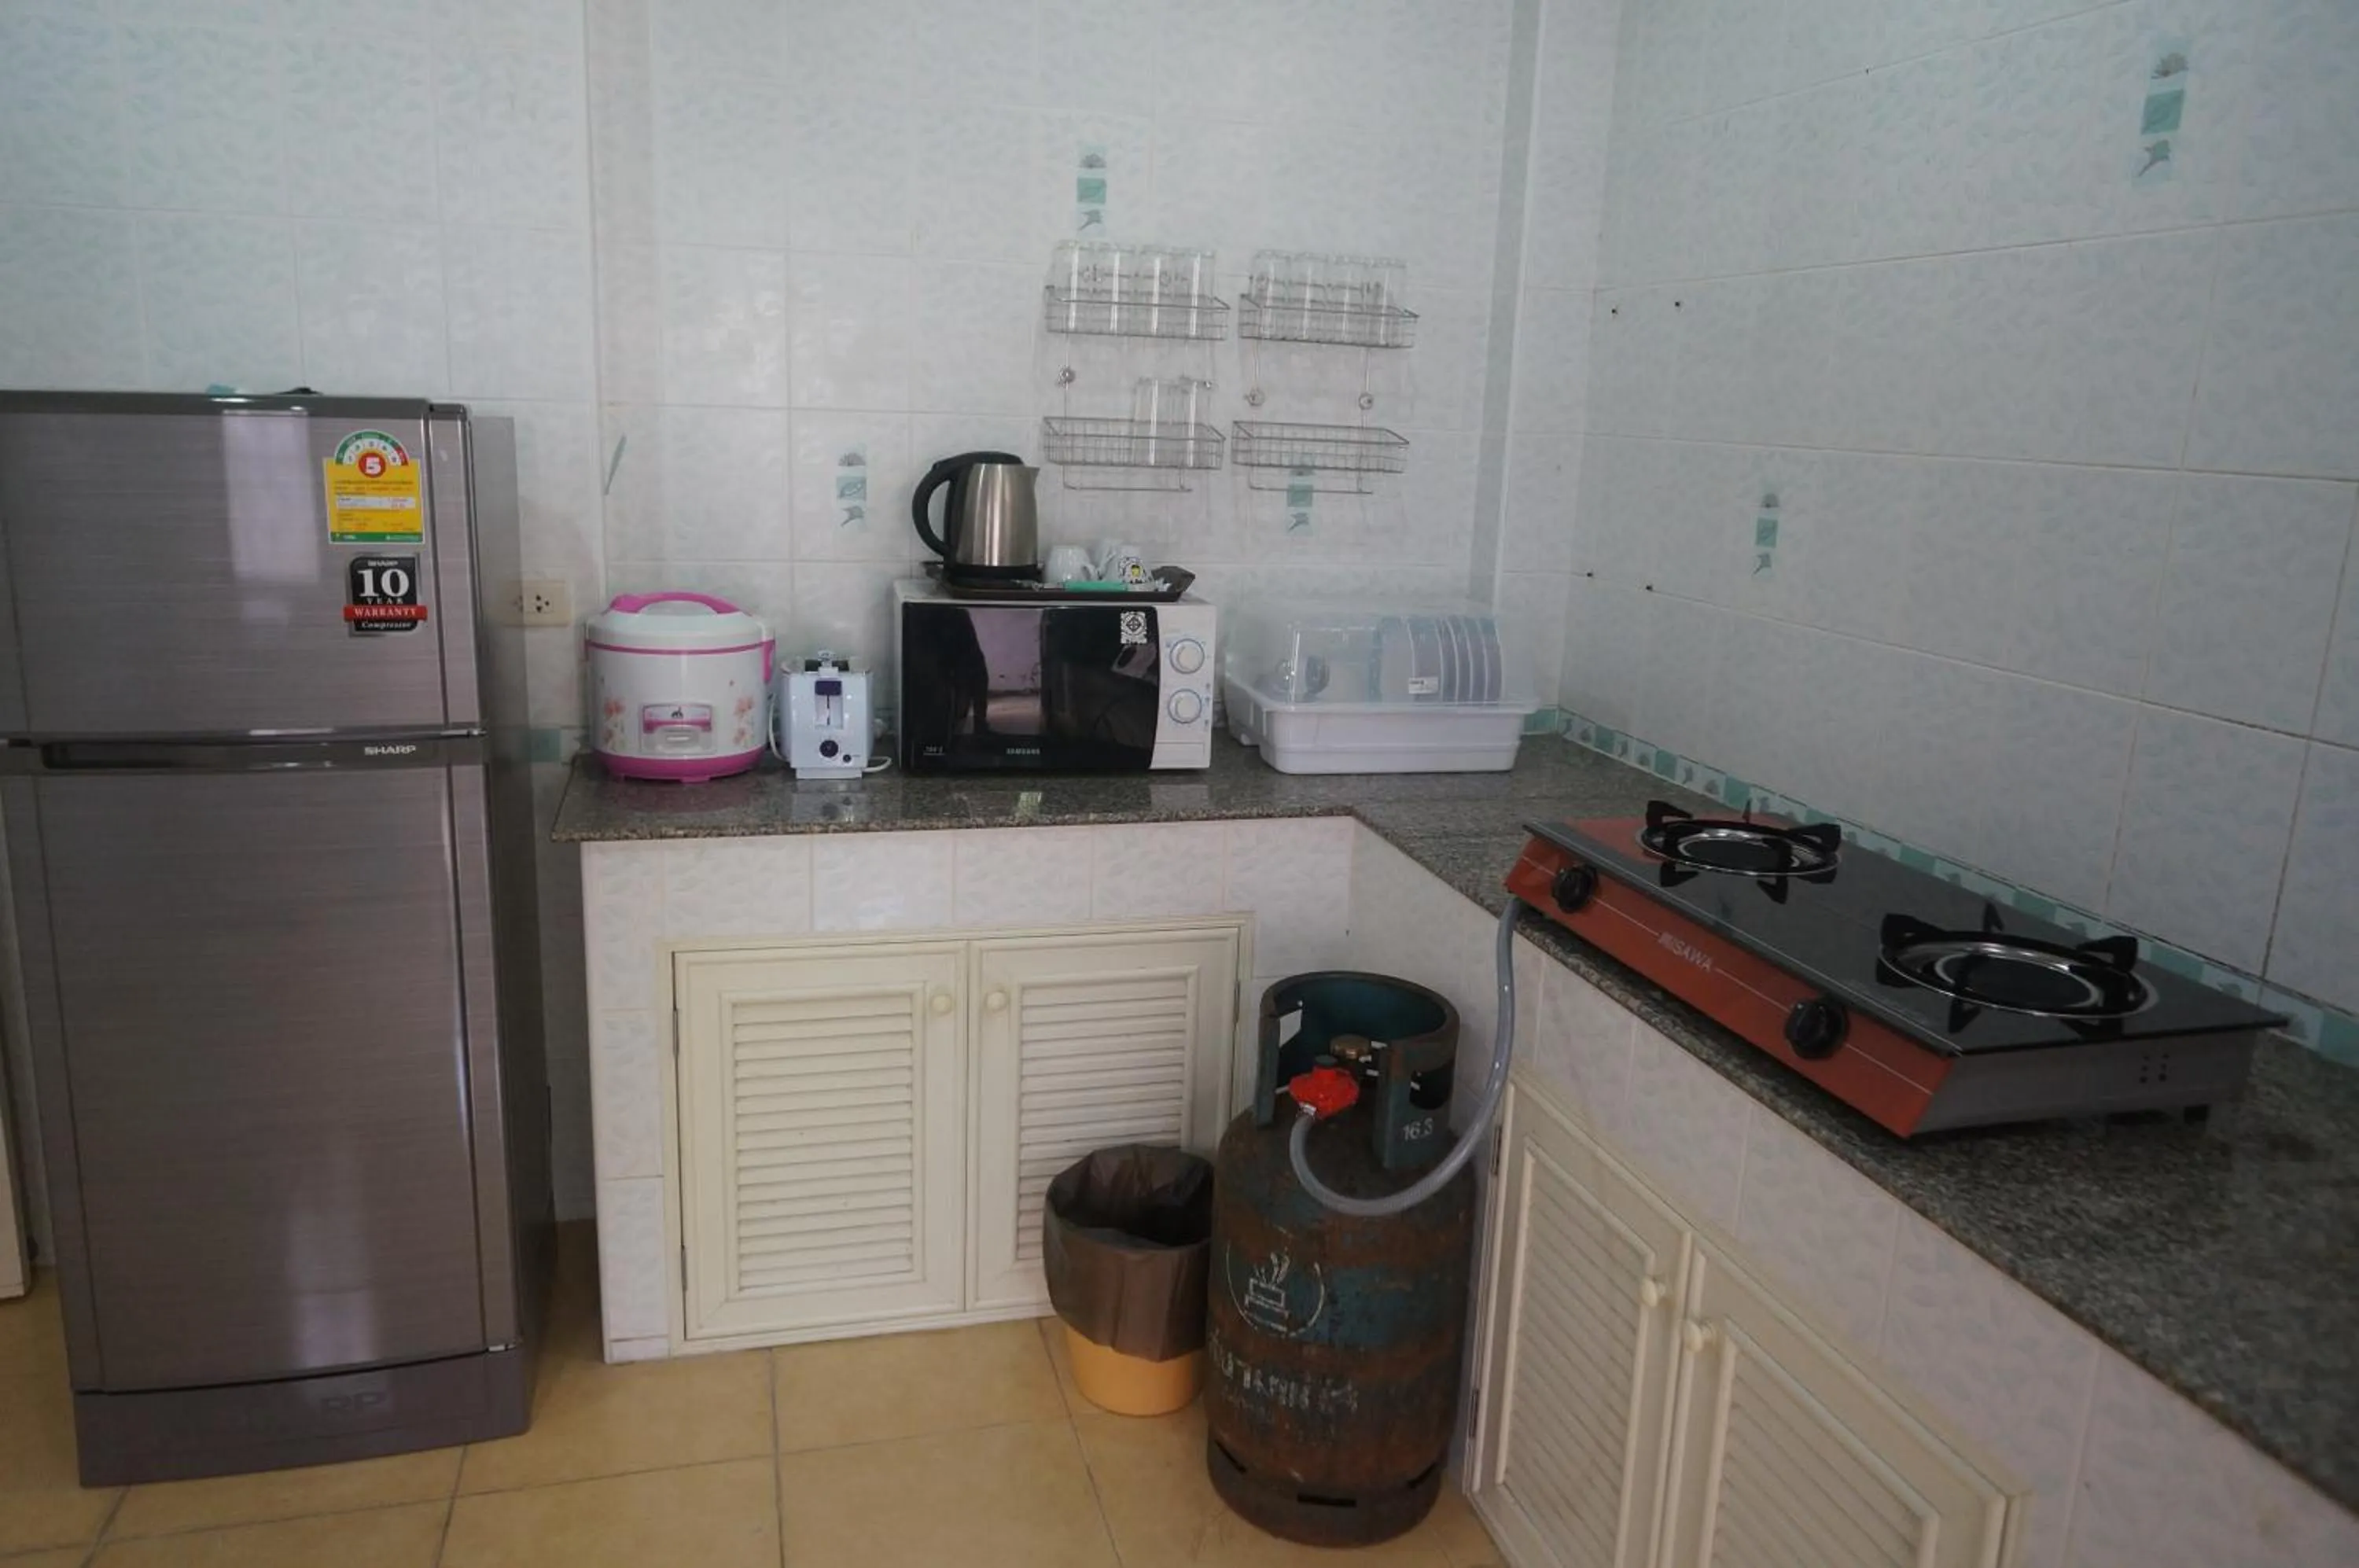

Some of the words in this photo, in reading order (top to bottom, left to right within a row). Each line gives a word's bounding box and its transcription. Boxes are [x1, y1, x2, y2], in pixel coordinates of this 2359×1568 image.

[357, 569, 410, 598] 10
[354, 607, 418, 617] WARRANTY
[364, 744, 416, 756] SHARP
